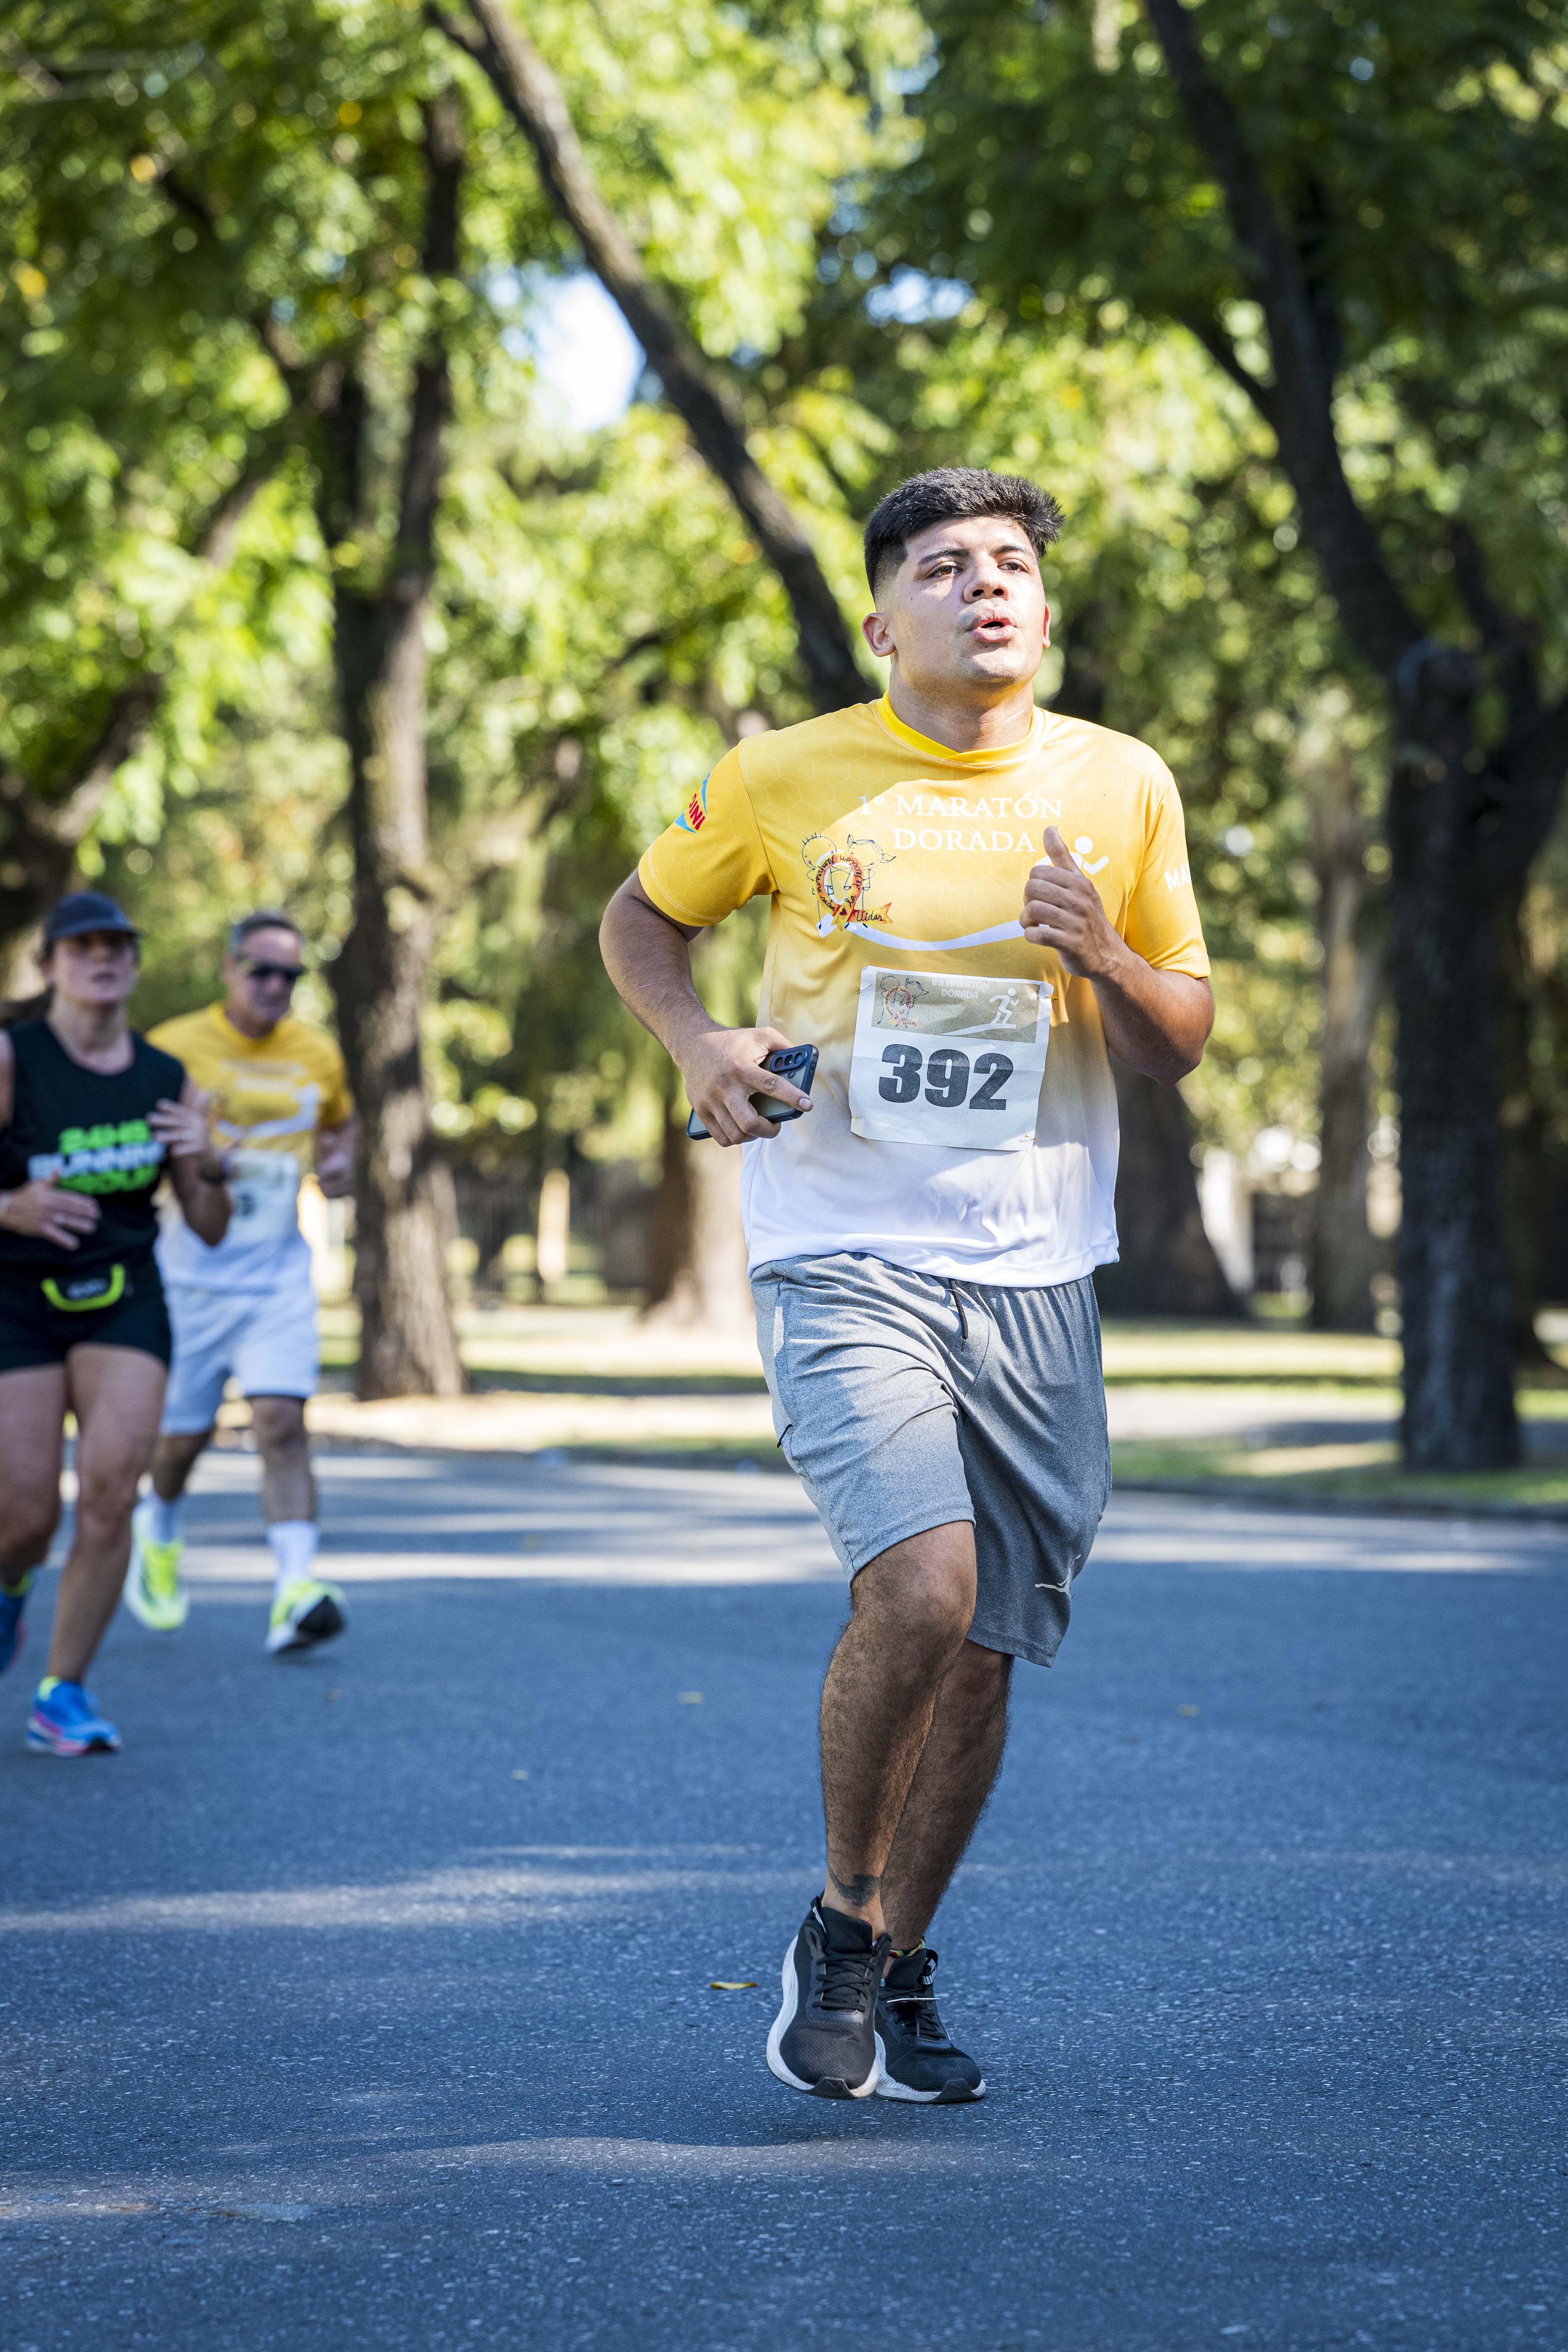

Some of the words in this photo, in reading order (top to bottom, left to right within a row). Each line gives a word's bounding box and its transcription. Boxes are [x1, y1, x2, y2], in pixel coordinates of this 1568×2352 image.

[894, 792, 1063, 818] MARATÓN
[891, 828, 1037, 852] DORADA
[941, 988, 979, 1000] DORADA
[878, 1044, 1014, 1111] 392
